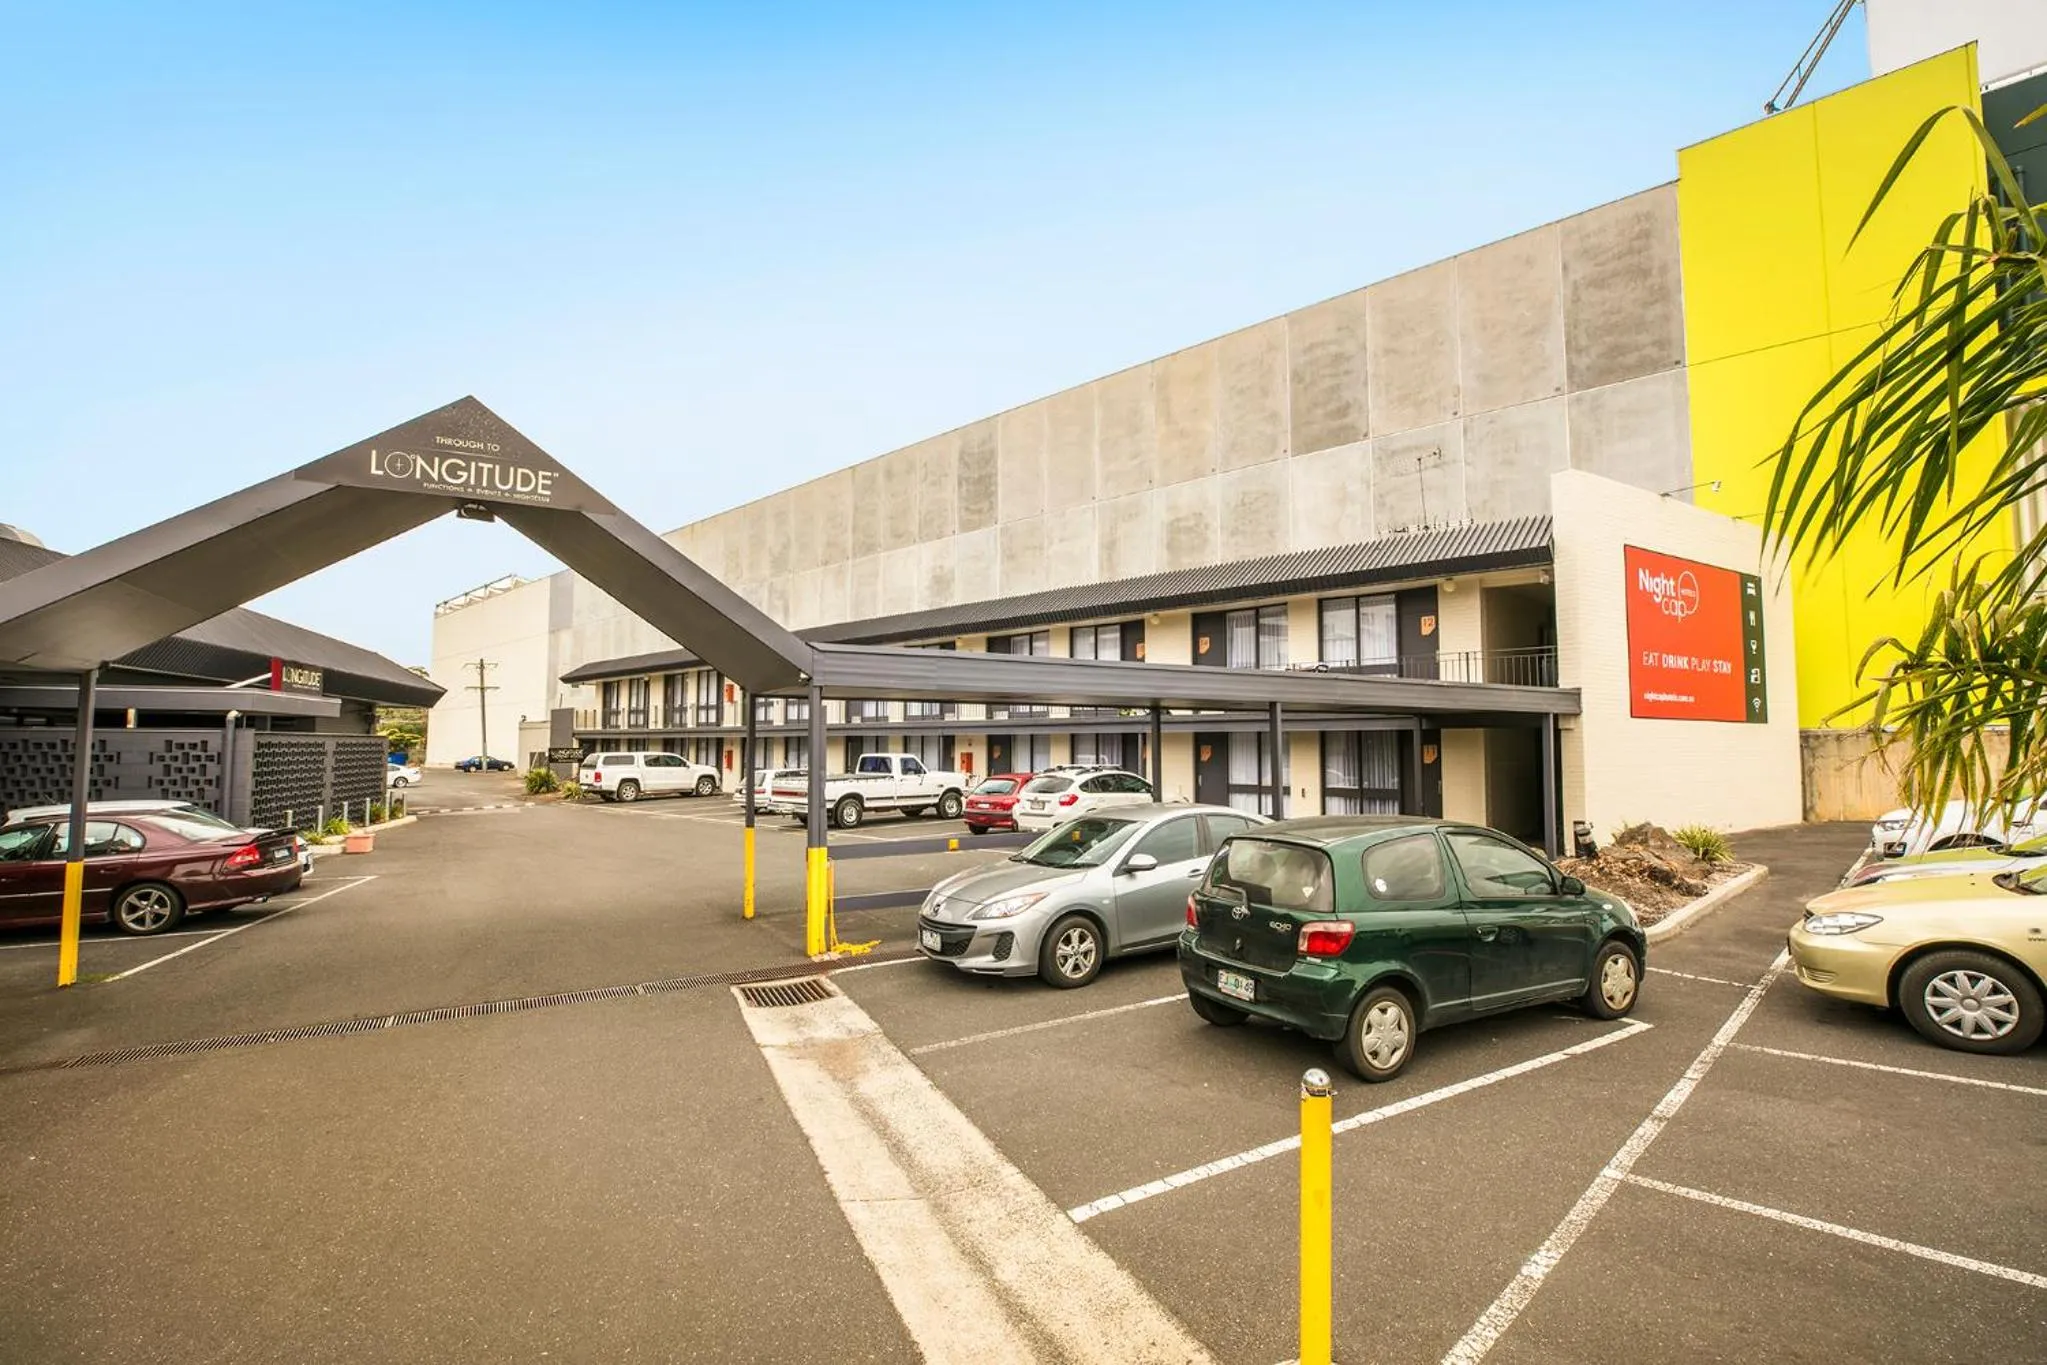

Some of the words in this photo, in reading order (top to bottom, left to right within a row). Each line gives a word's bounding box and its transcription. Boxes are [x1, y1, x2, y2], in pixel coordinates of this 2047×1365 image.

[435, 435, 484, 450] THROUGH
[487, 442, 500, 452] TO
[370, 449, 553, 496] LONGITUDE
[1638, 567, 1677, 603] Night
[1661, 598, 1688, 624] cap
[1642, 650, 1660, 668] EAT
[1661, 653, 1690, 671] DRINK
[1690, 656, 1712, 673] PLAY
[1713, 659, 1732, 675] STAY
